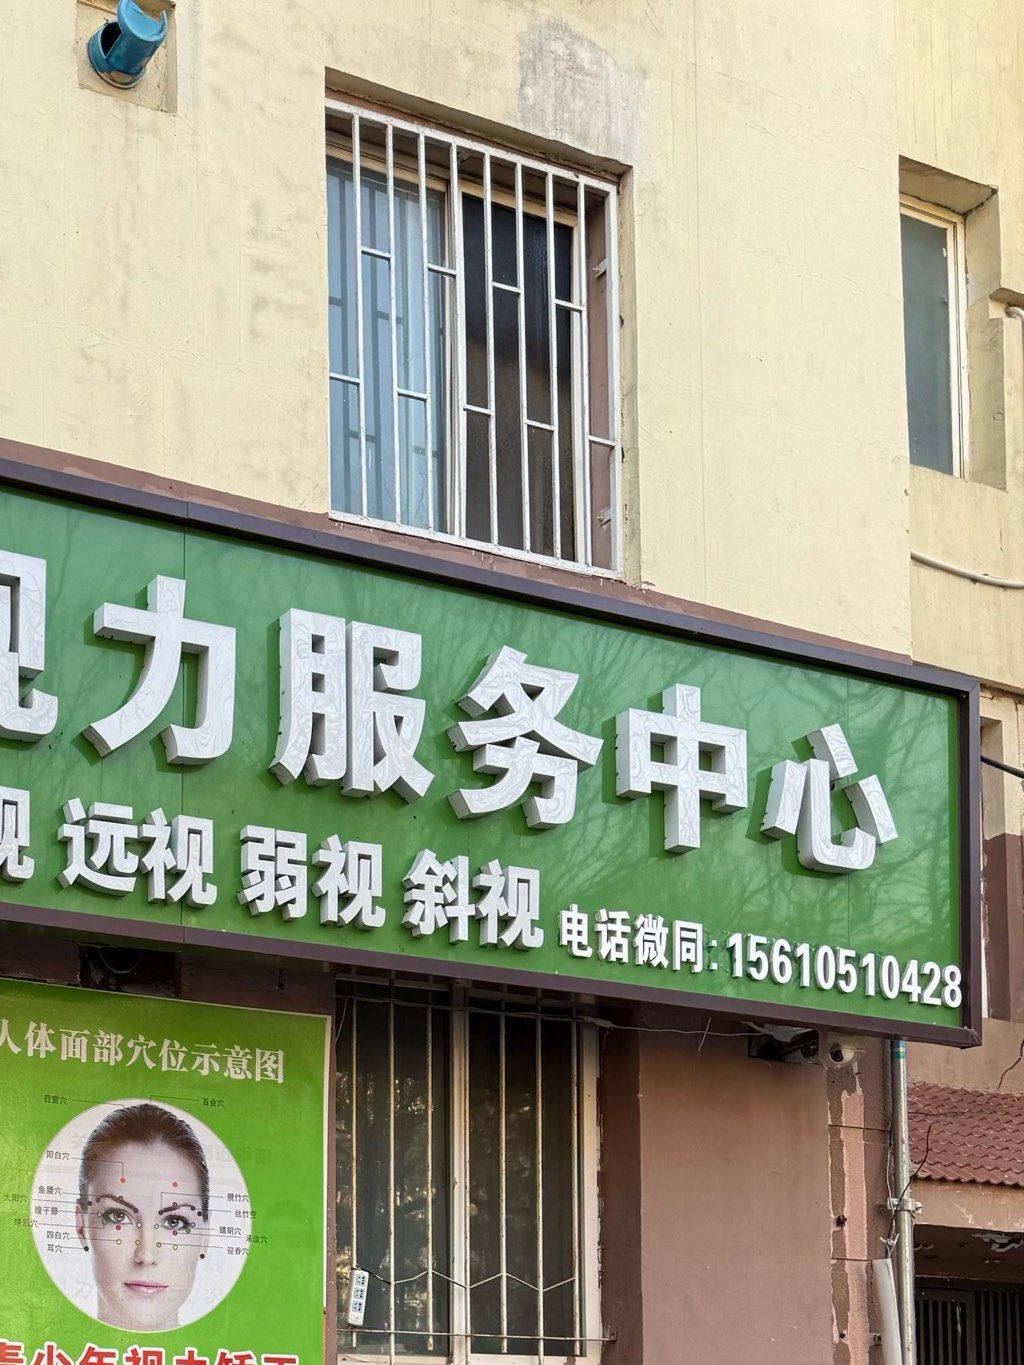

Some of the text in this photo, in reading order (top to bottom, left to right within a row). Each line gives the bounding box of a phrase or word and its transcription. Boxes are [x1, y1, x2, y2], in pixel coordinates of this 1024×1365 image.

[57, 798, 218, 908] 远视
[237, 824, 386, 930] 弱视
[401, 848, 544, 950] 斜视
